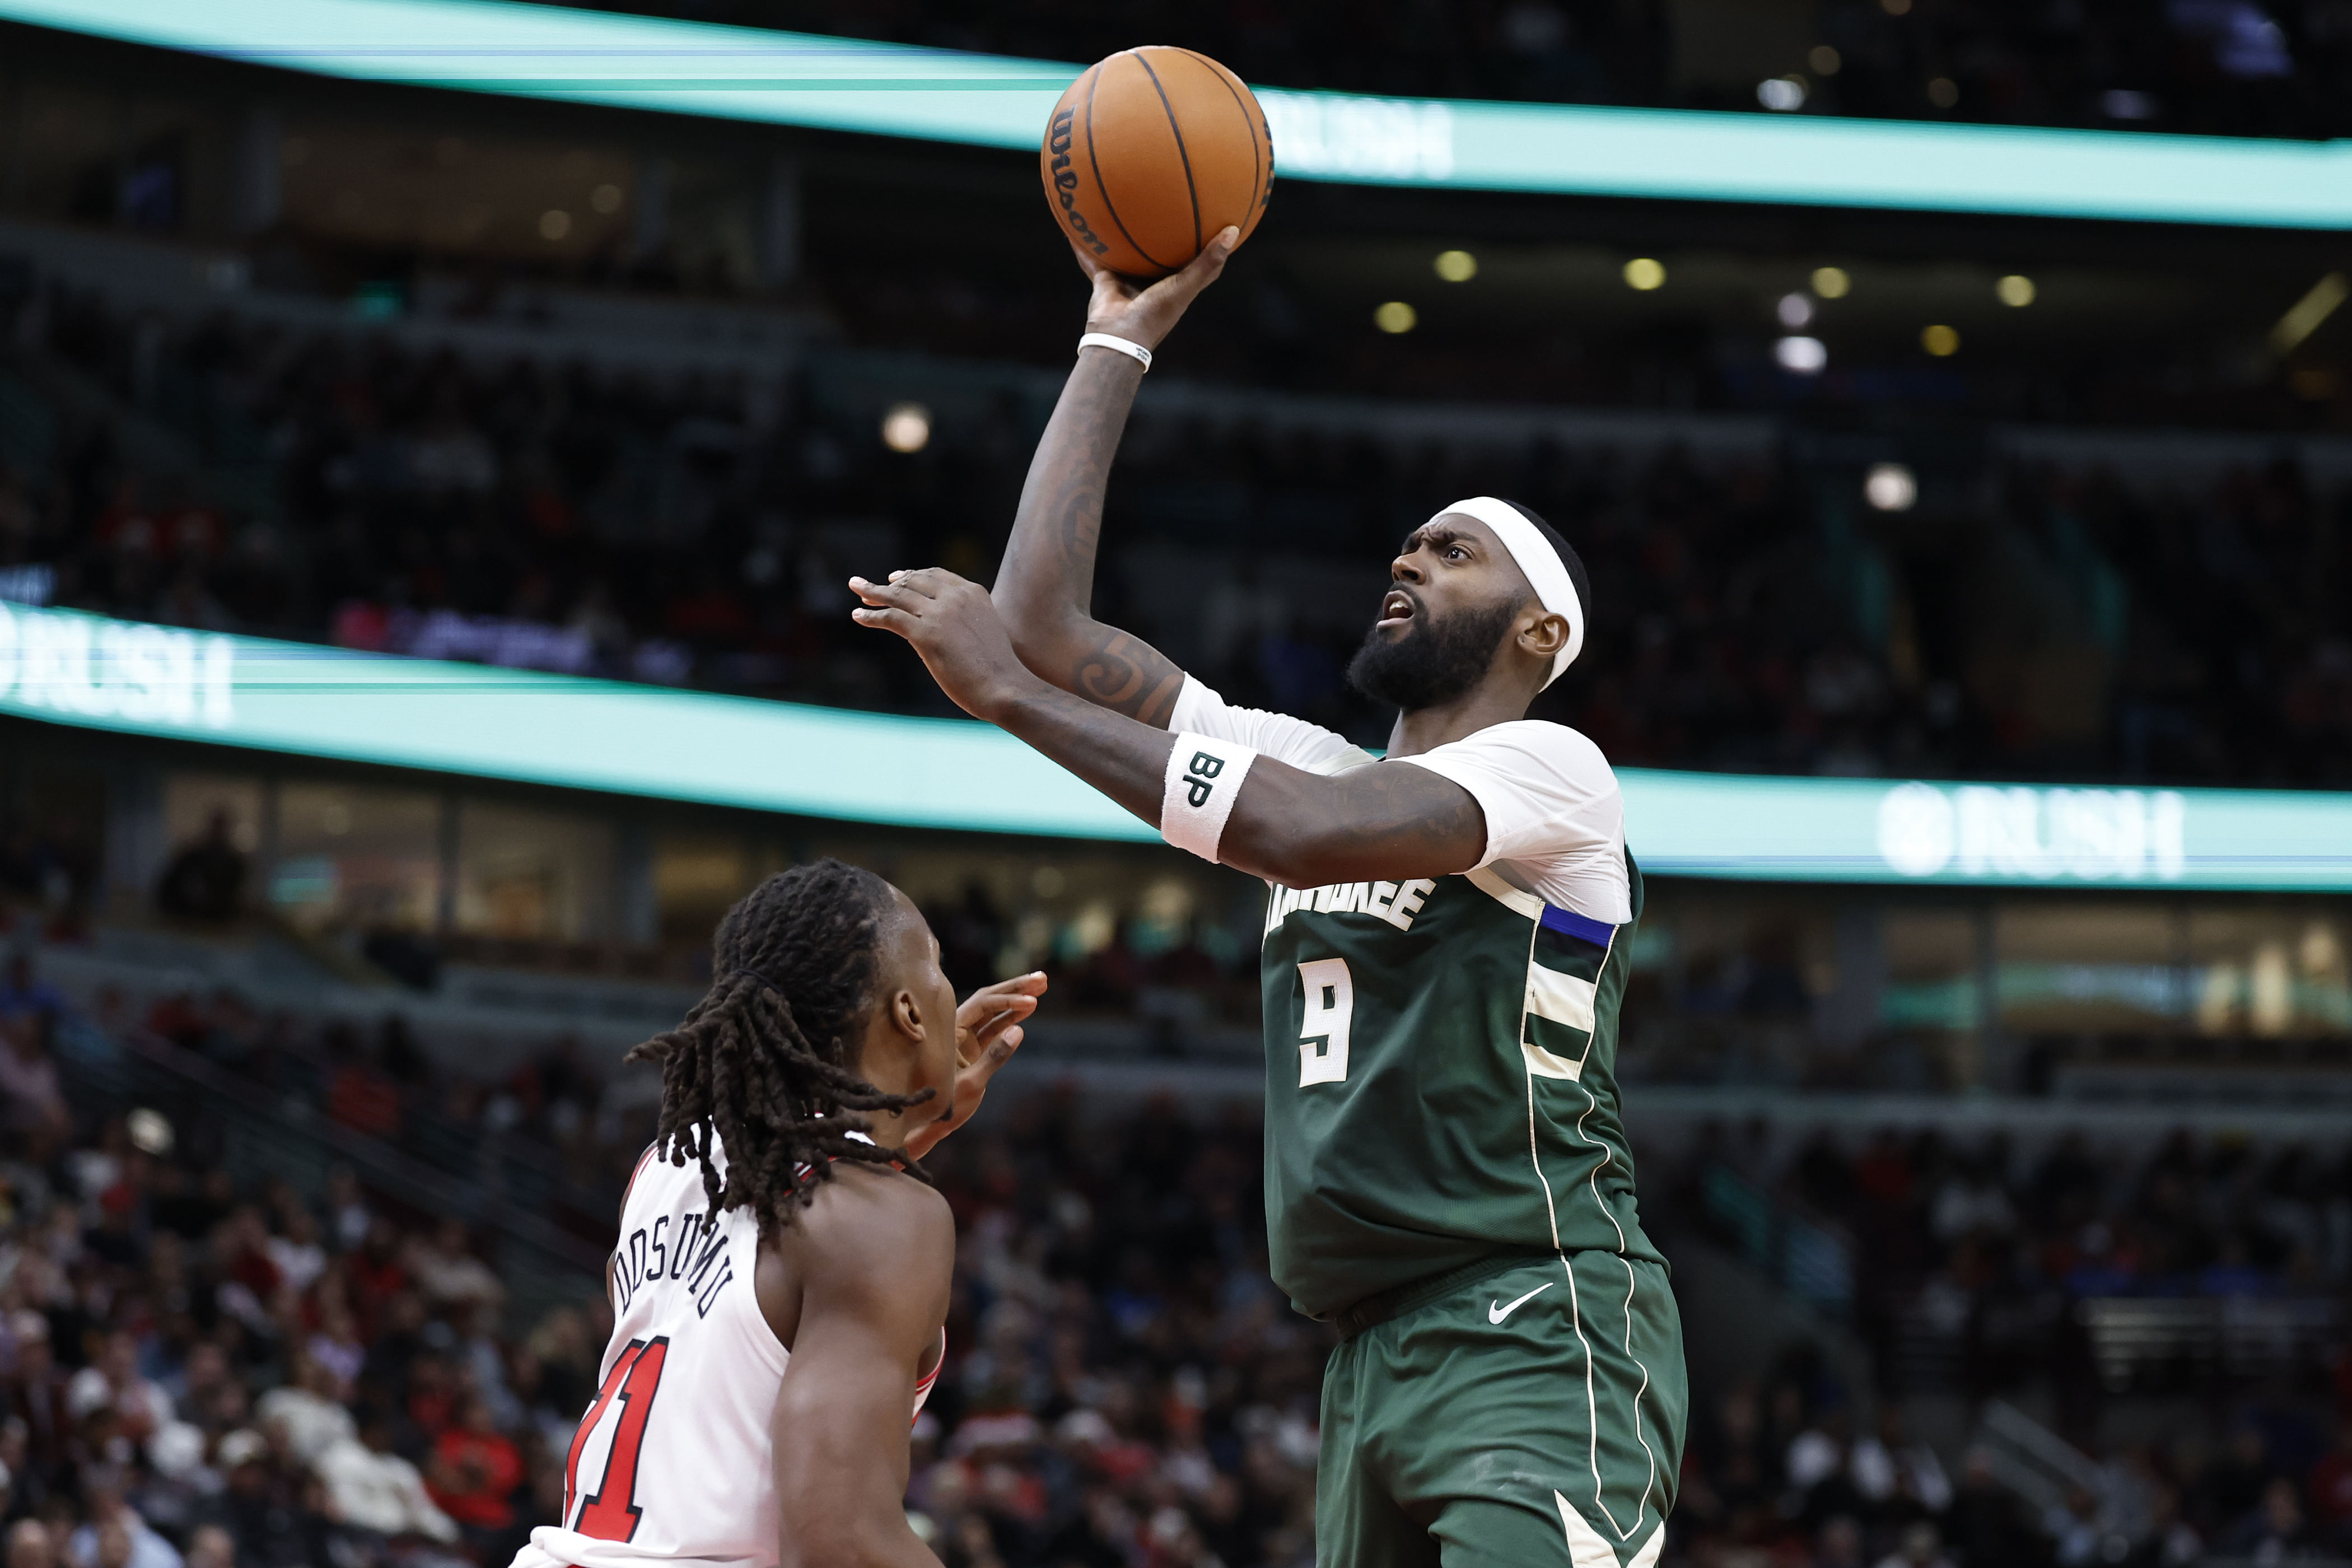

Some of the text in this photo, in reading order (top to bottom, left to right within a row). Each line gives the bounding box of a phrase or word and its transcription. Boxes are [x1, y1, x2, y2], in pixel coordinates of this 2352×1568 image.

[1050, 103, 1109, 255] Wilson
[20, 613, 231, 729] RUSH
[1183, 751, 1225, 807] BP
[1957, 786, 2185, 879] RUSH
[1262, 878, 1437, 943] LWAUKEE
[1298, 958, 1354, 1088] 9
[614, 1214, 733, 1319] DOSUMU
[563, 1335, 670, 1544] 11
